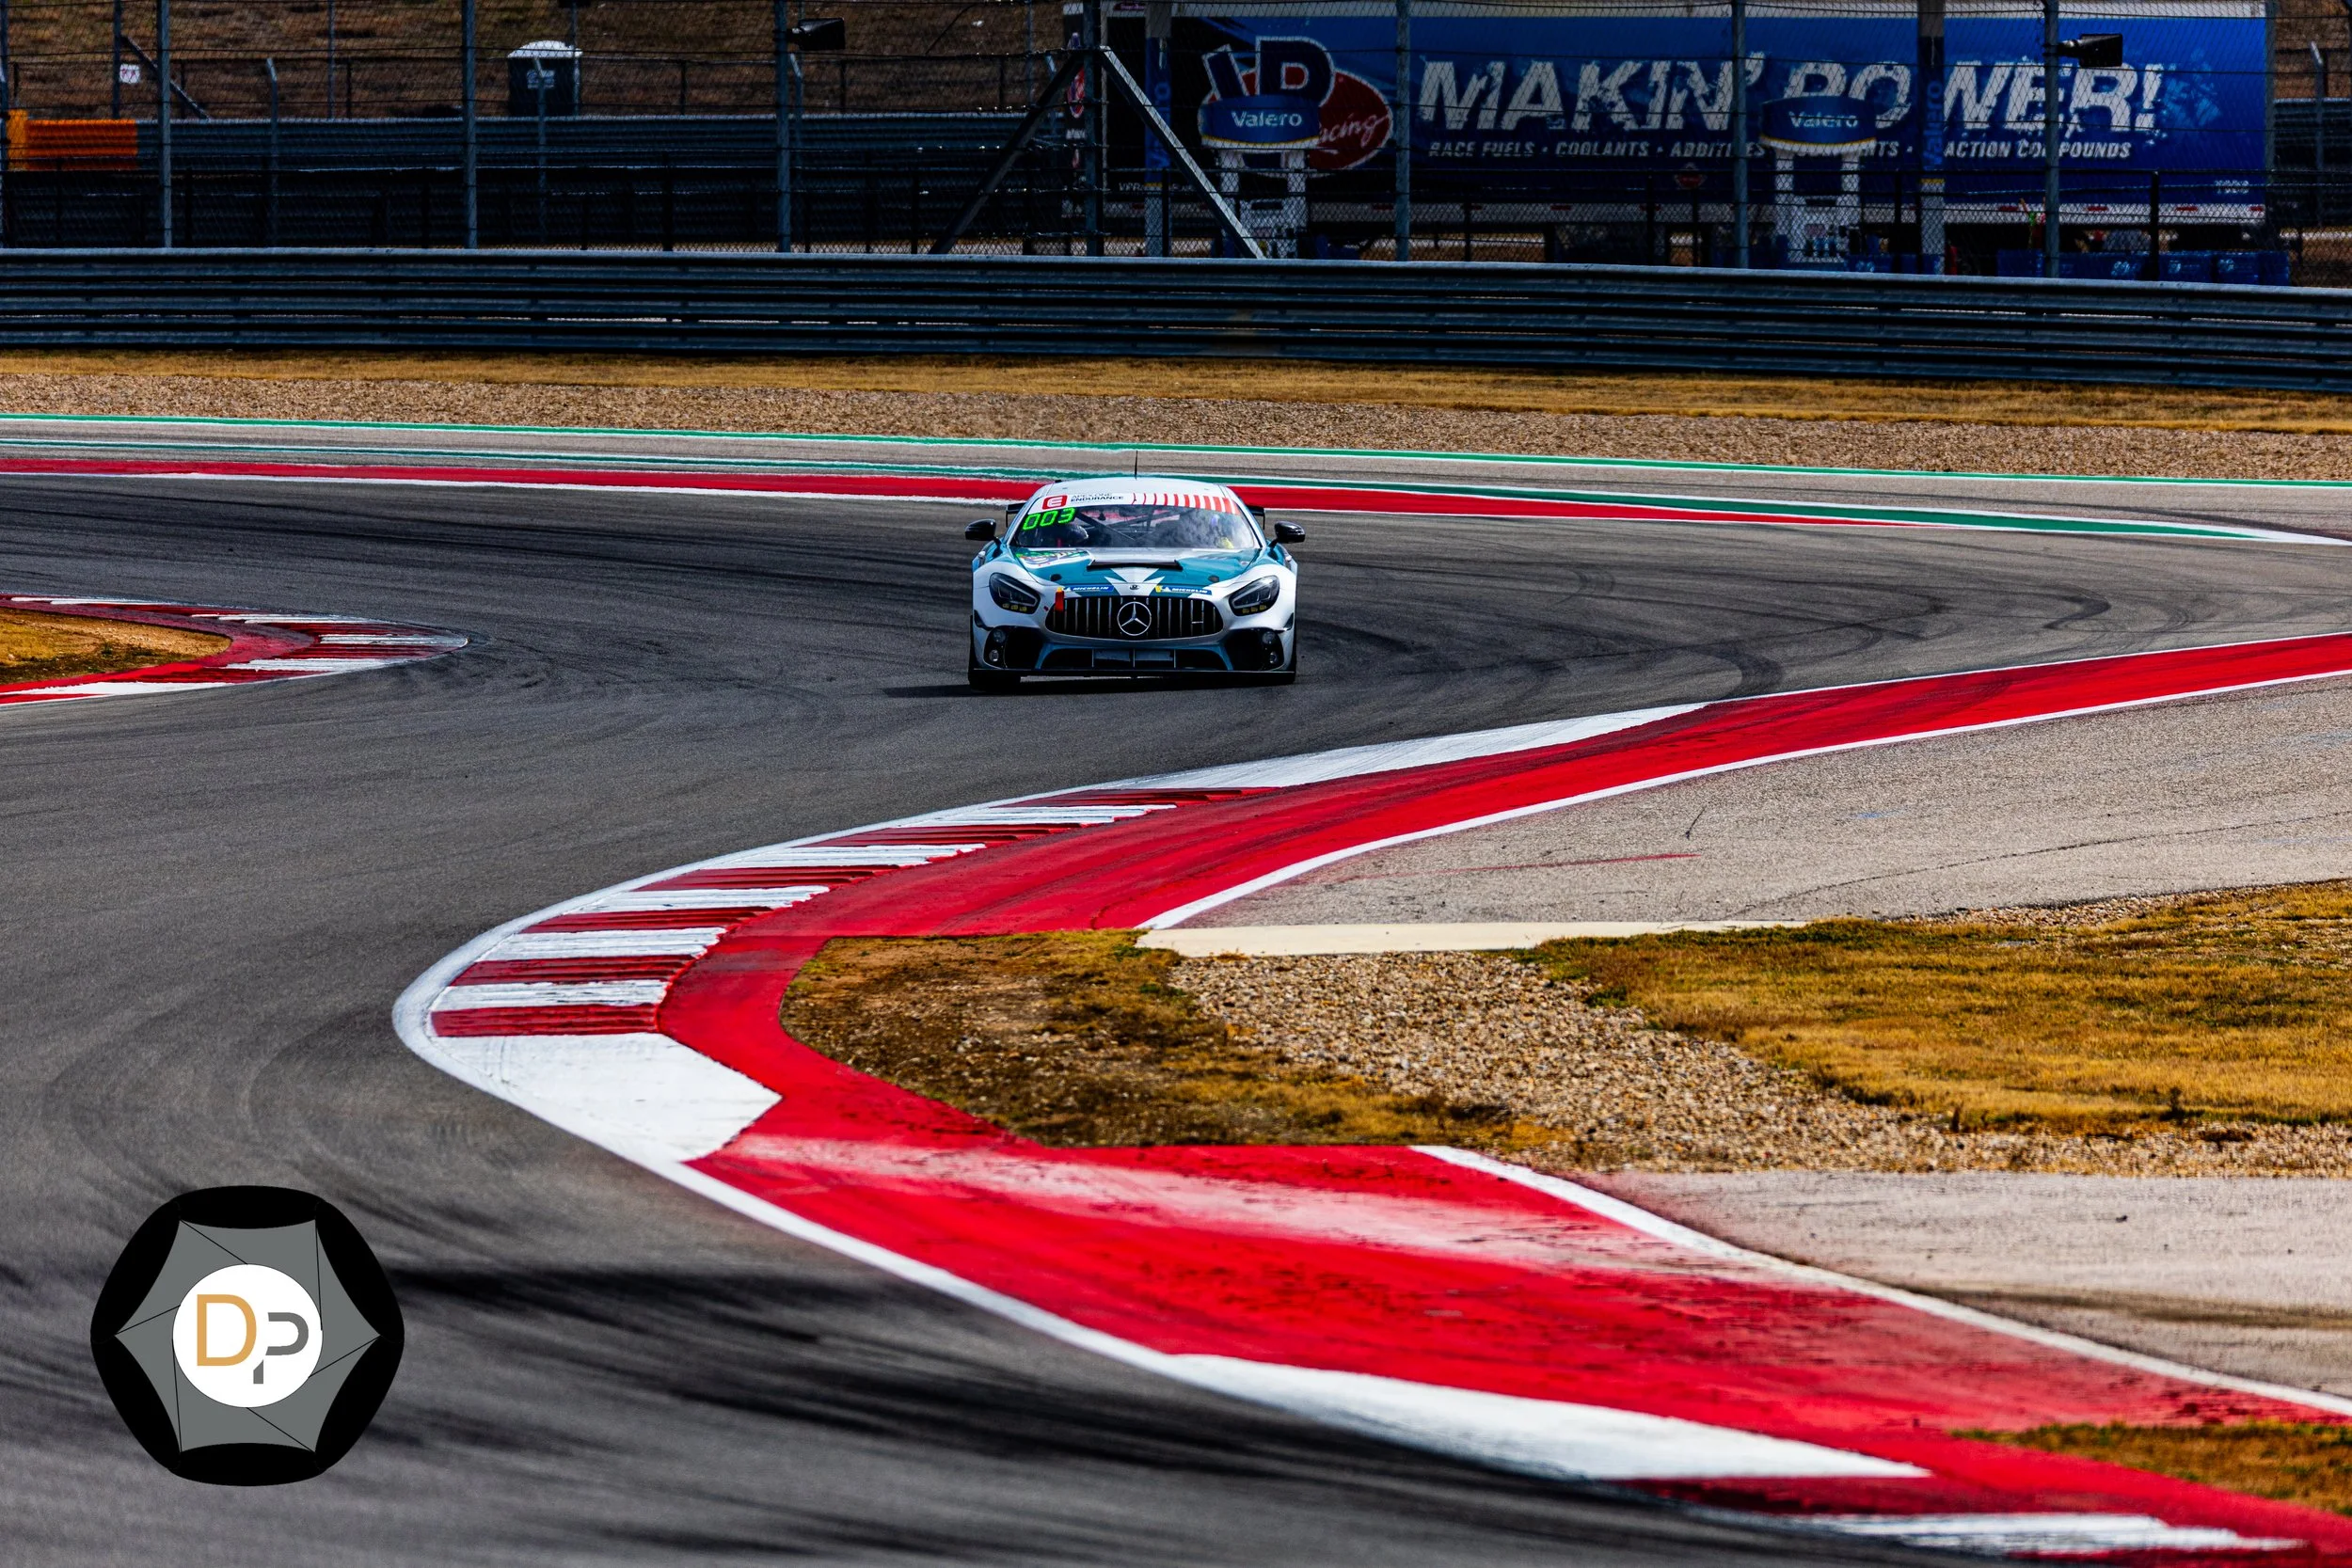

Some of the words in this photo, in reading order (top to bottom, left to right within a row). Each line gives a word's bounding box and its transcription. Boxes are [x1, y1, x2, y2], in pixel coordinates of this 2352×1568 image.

[1418, 52, 1765, 131] MAKIN'
[1232, 110, 1303, 128] Valero
[1788, 110, 1860, 128] Valero
[1318, 113, 1388, 148] acing
[1428, 140, 1477, 158] RACE
[1482, 140, 1536, 158] FUELS
[1554, 140, 1651, 158] COOLANTS
[1669, 140, 1767, 159] ADDITIES
[1944, 139, 2012, 159] ACTION
[2016, 138, 2132, 160] COPOUNDS
[1022, 507, 1076, 531] 003
